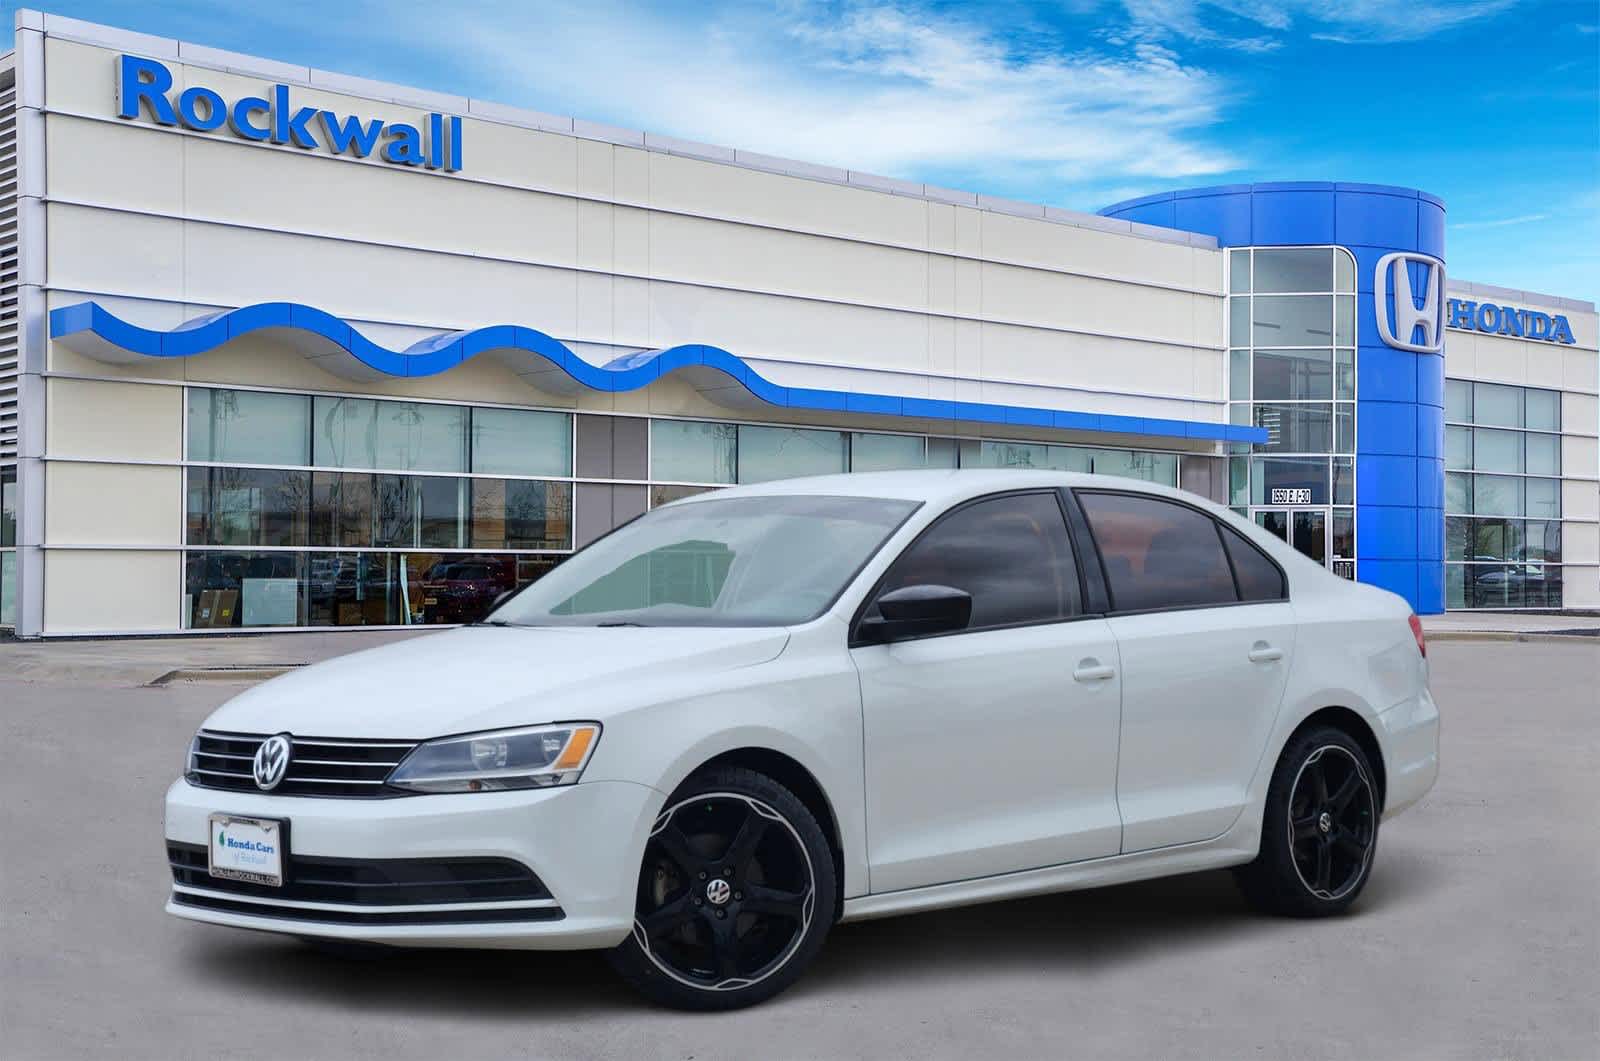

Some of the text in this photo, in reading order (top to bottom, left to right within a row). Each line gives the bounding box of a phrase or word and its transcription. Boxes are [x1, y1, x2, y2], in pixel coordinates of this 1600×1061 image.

[116, 54, 463, 172] Rockwall
[1447, 298, 1577, 344] HONDA
[227, 837, 255, 851] Honda
